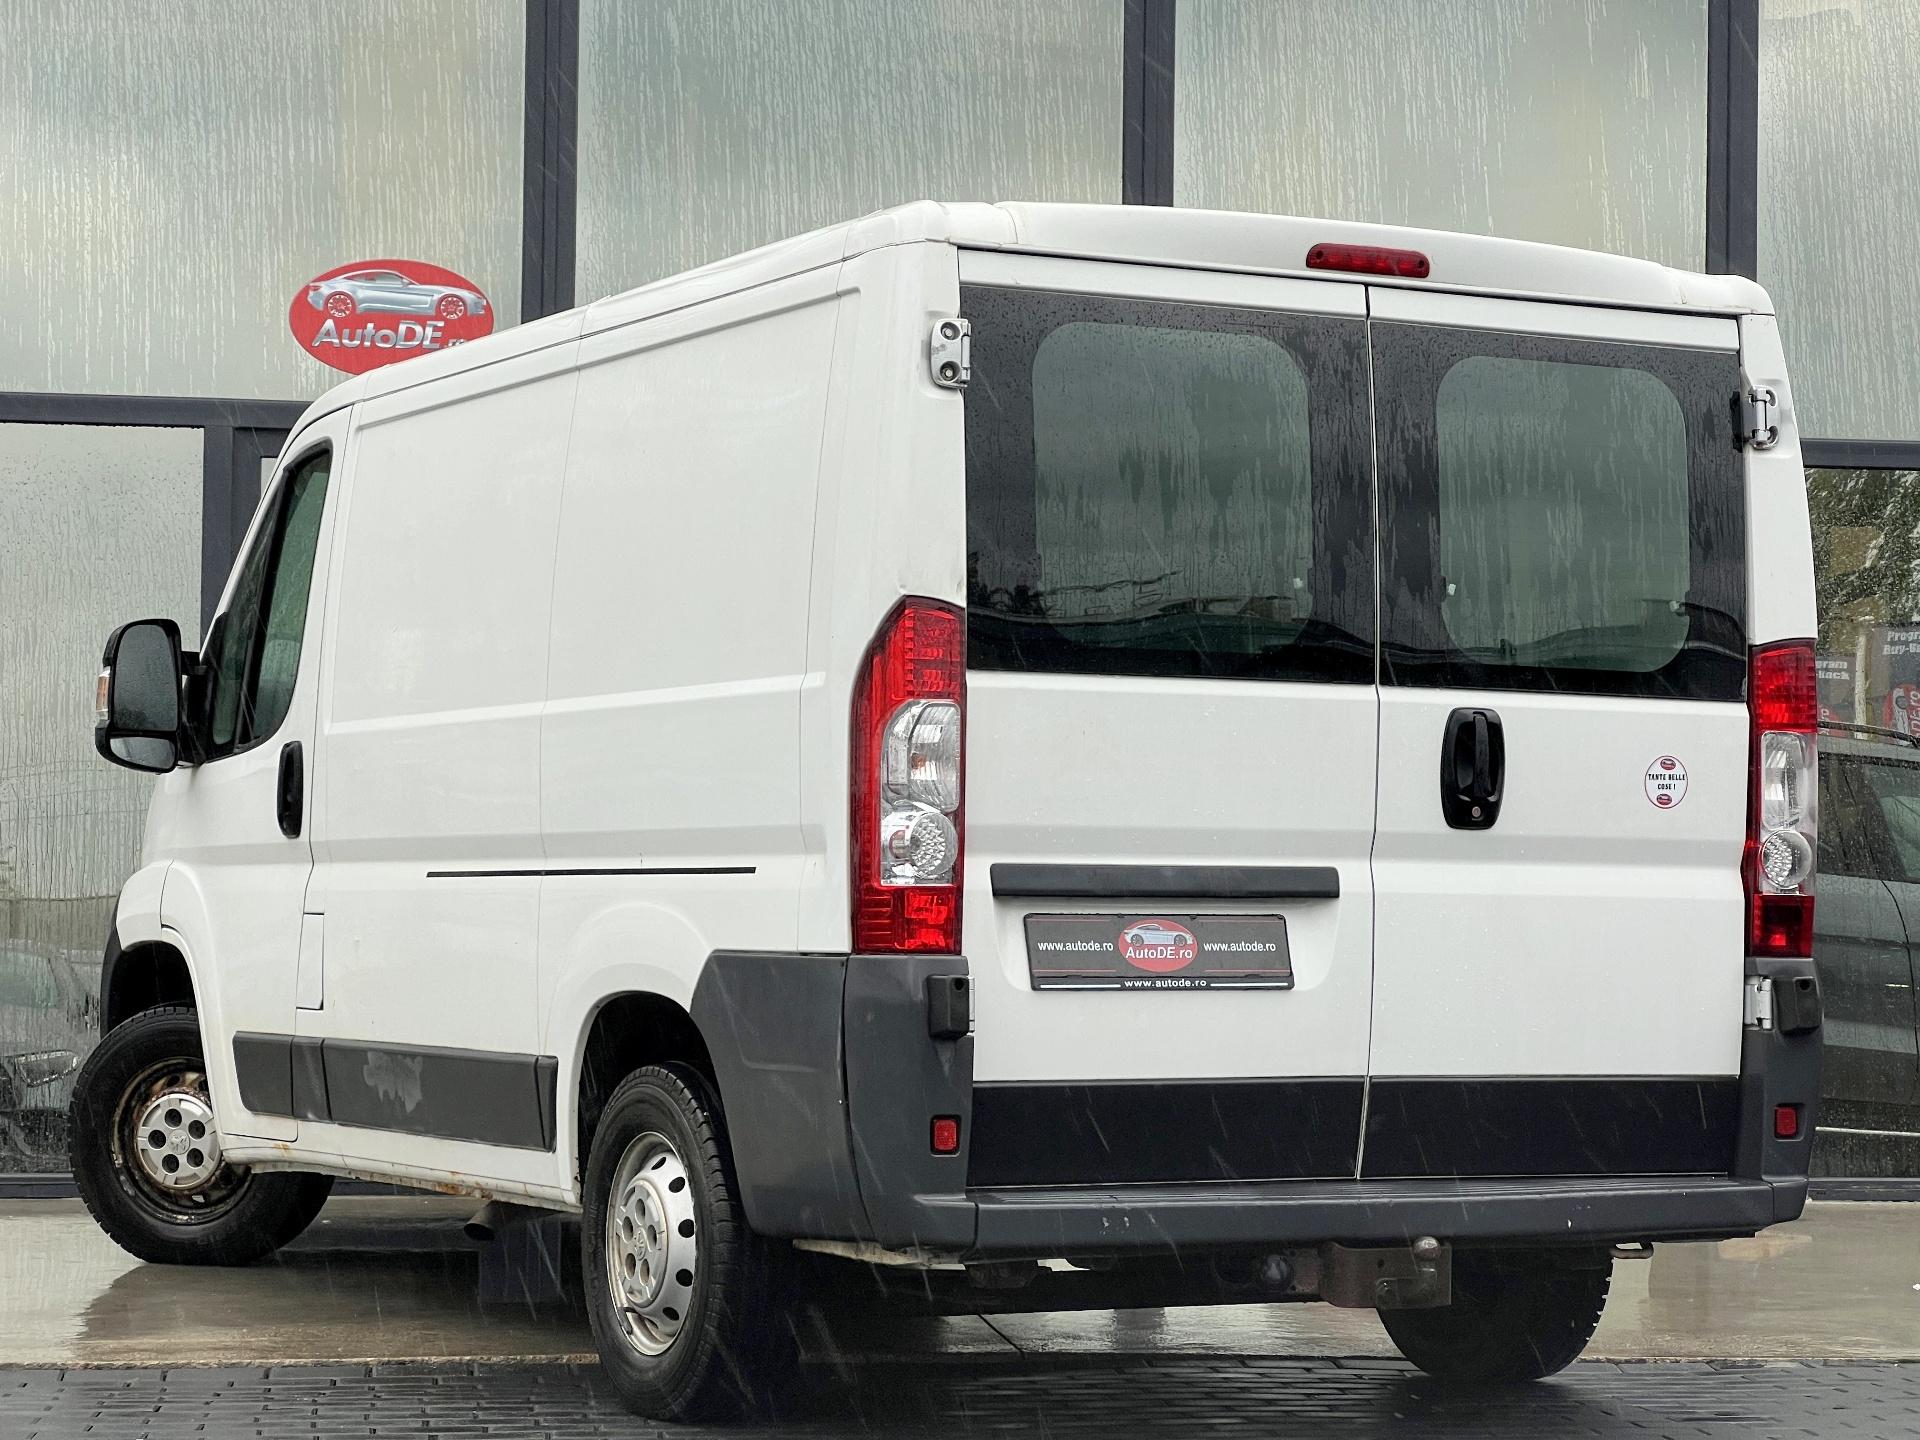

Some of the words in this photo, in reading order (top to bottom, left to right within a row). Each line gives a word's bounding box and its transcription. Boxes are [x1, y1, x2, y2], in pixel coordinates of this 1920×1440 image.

[1037, 939, 1114, 952] www.autode.ro
[1203, 941, 1276, 952] www.autode.ro
[1125, 946, 1193, 960] AutoDE.ro
[1124, 979, 1207, 988] www.autode.ro
